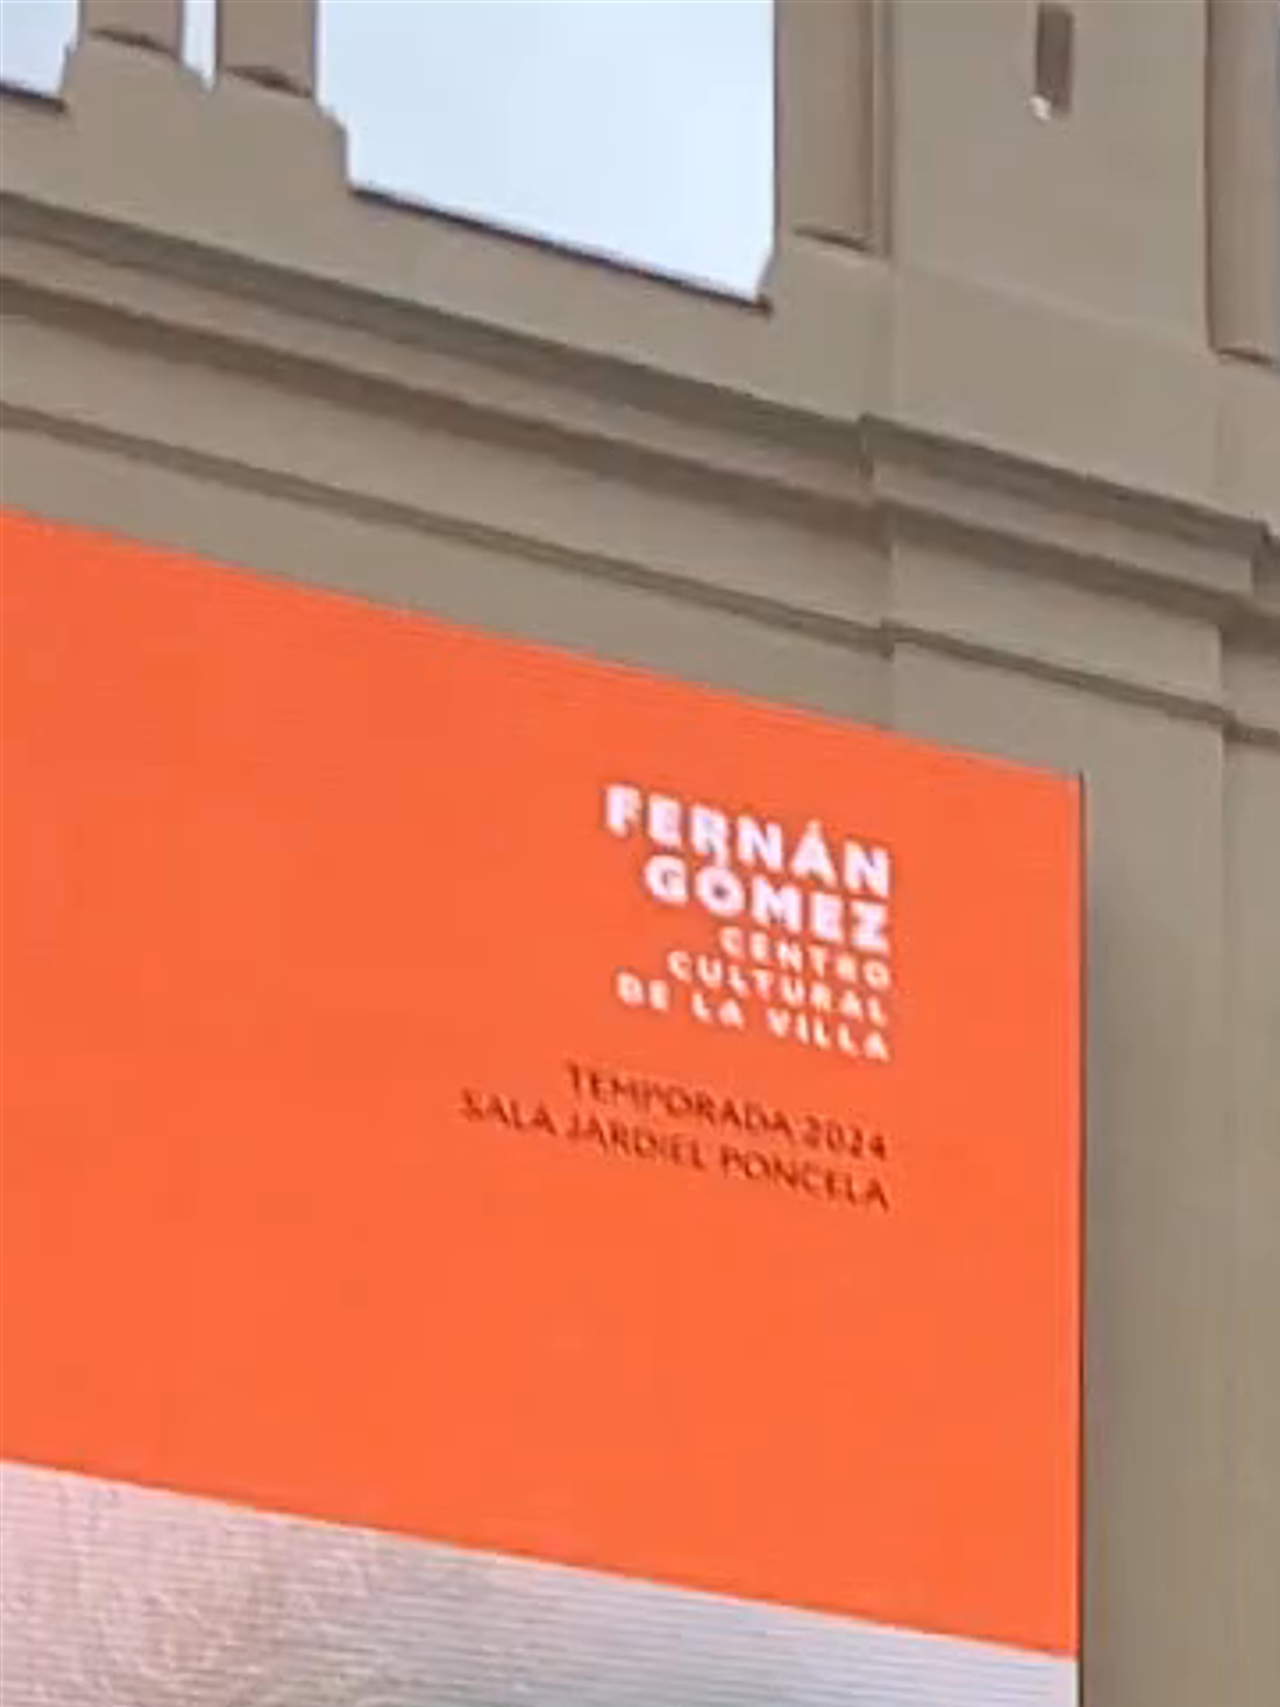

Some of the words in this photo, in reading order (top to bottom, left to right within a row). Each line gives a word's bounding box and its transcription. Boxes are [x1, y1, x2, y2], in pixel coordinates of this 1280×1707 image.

[605, 783, 890, 897] FERNÁN
[667, 949, 887, 1026] CULTURAL
[720, 926, 890, 989] CENTRO
[617, 970, 669, 1011] DE
[692, 991, 743, 1029] LA
[766, 1007, 890, 1062] VILLA
[461, 1088, 557, 1137] SALA
[567, 1112, 707, 1171] JARDIEL
[719, 1144, 890, 1213] PONCELA
[566, 1061, 794, 1139] TEMPORADA
[802, 1114, 887, 1161] 2024
